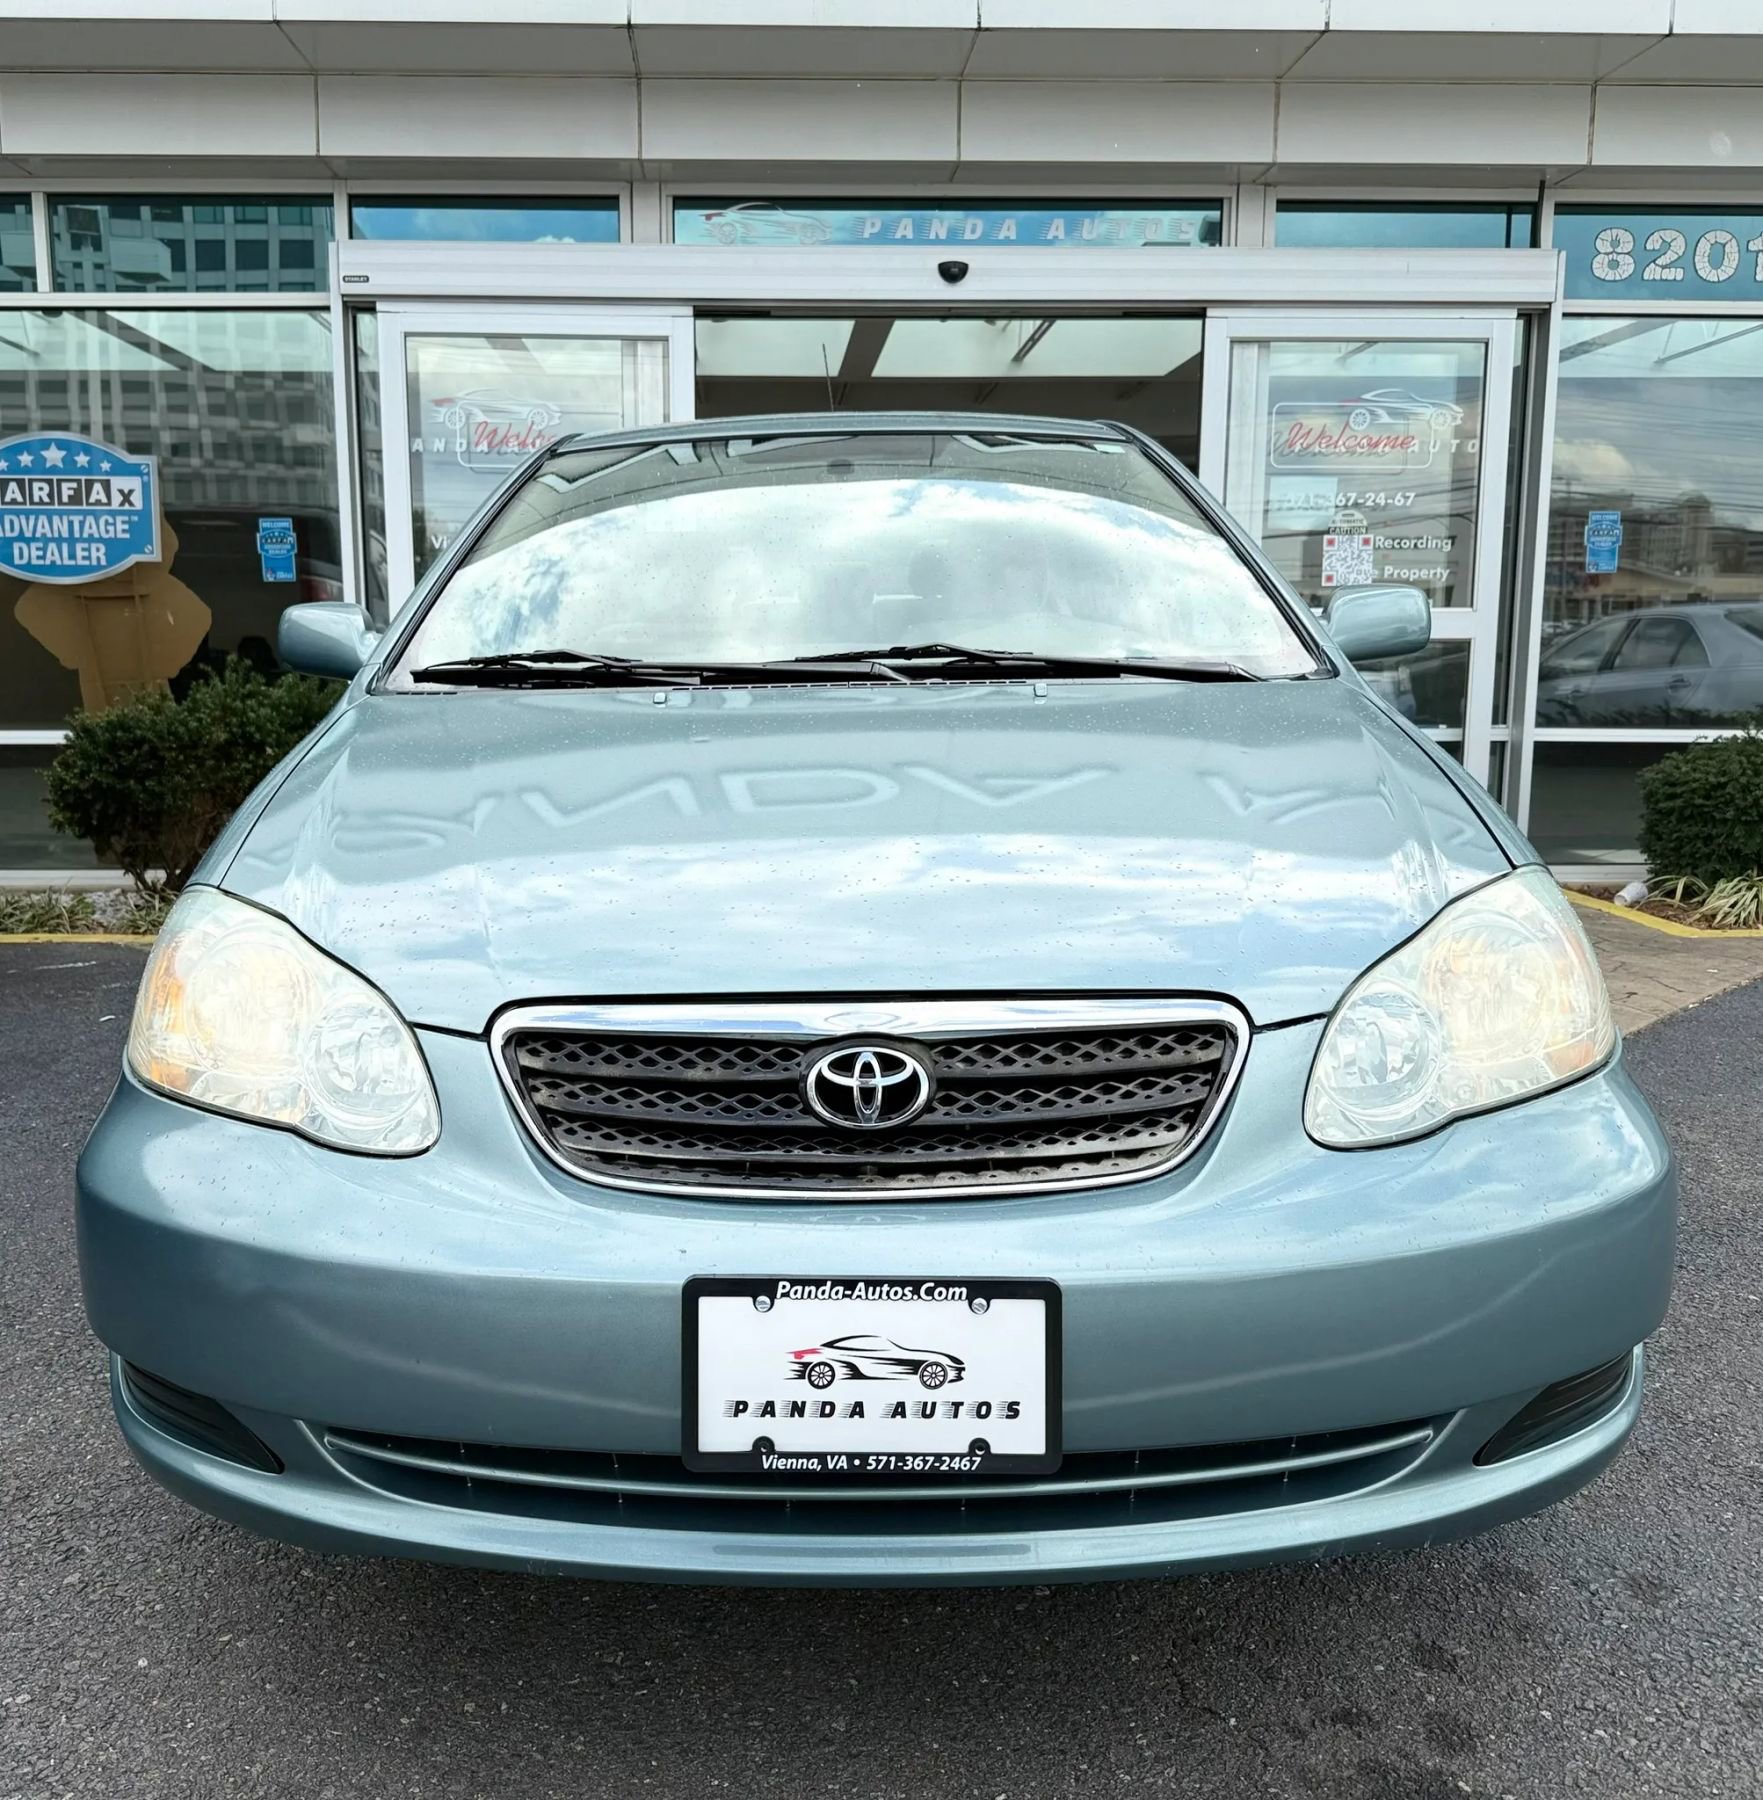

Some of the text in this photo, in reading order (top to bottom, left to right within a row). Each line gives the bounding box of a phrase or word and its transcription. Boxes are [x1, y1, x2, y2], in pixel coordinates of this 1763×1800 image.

[861, 217, 1195, 241] PANDA AUTOS
[1288, 422, 1415, 450] Welcome
[1407, 439, 1478, 454] AUTO
[1329, 527, 1367, 535] CAUTION
[1375, 535, 1452, 551] Recording
[13, 541, 107, 566] DEALER
[1384, 565, 1450, 581] Property
[775, 1281, 968, 1301] Panda-Autos.Com
[728, 1400, 1021, 1420] PANDA AUTOS
[761, 1454, 982, 1472] Vienna, VA 571-367-2467
